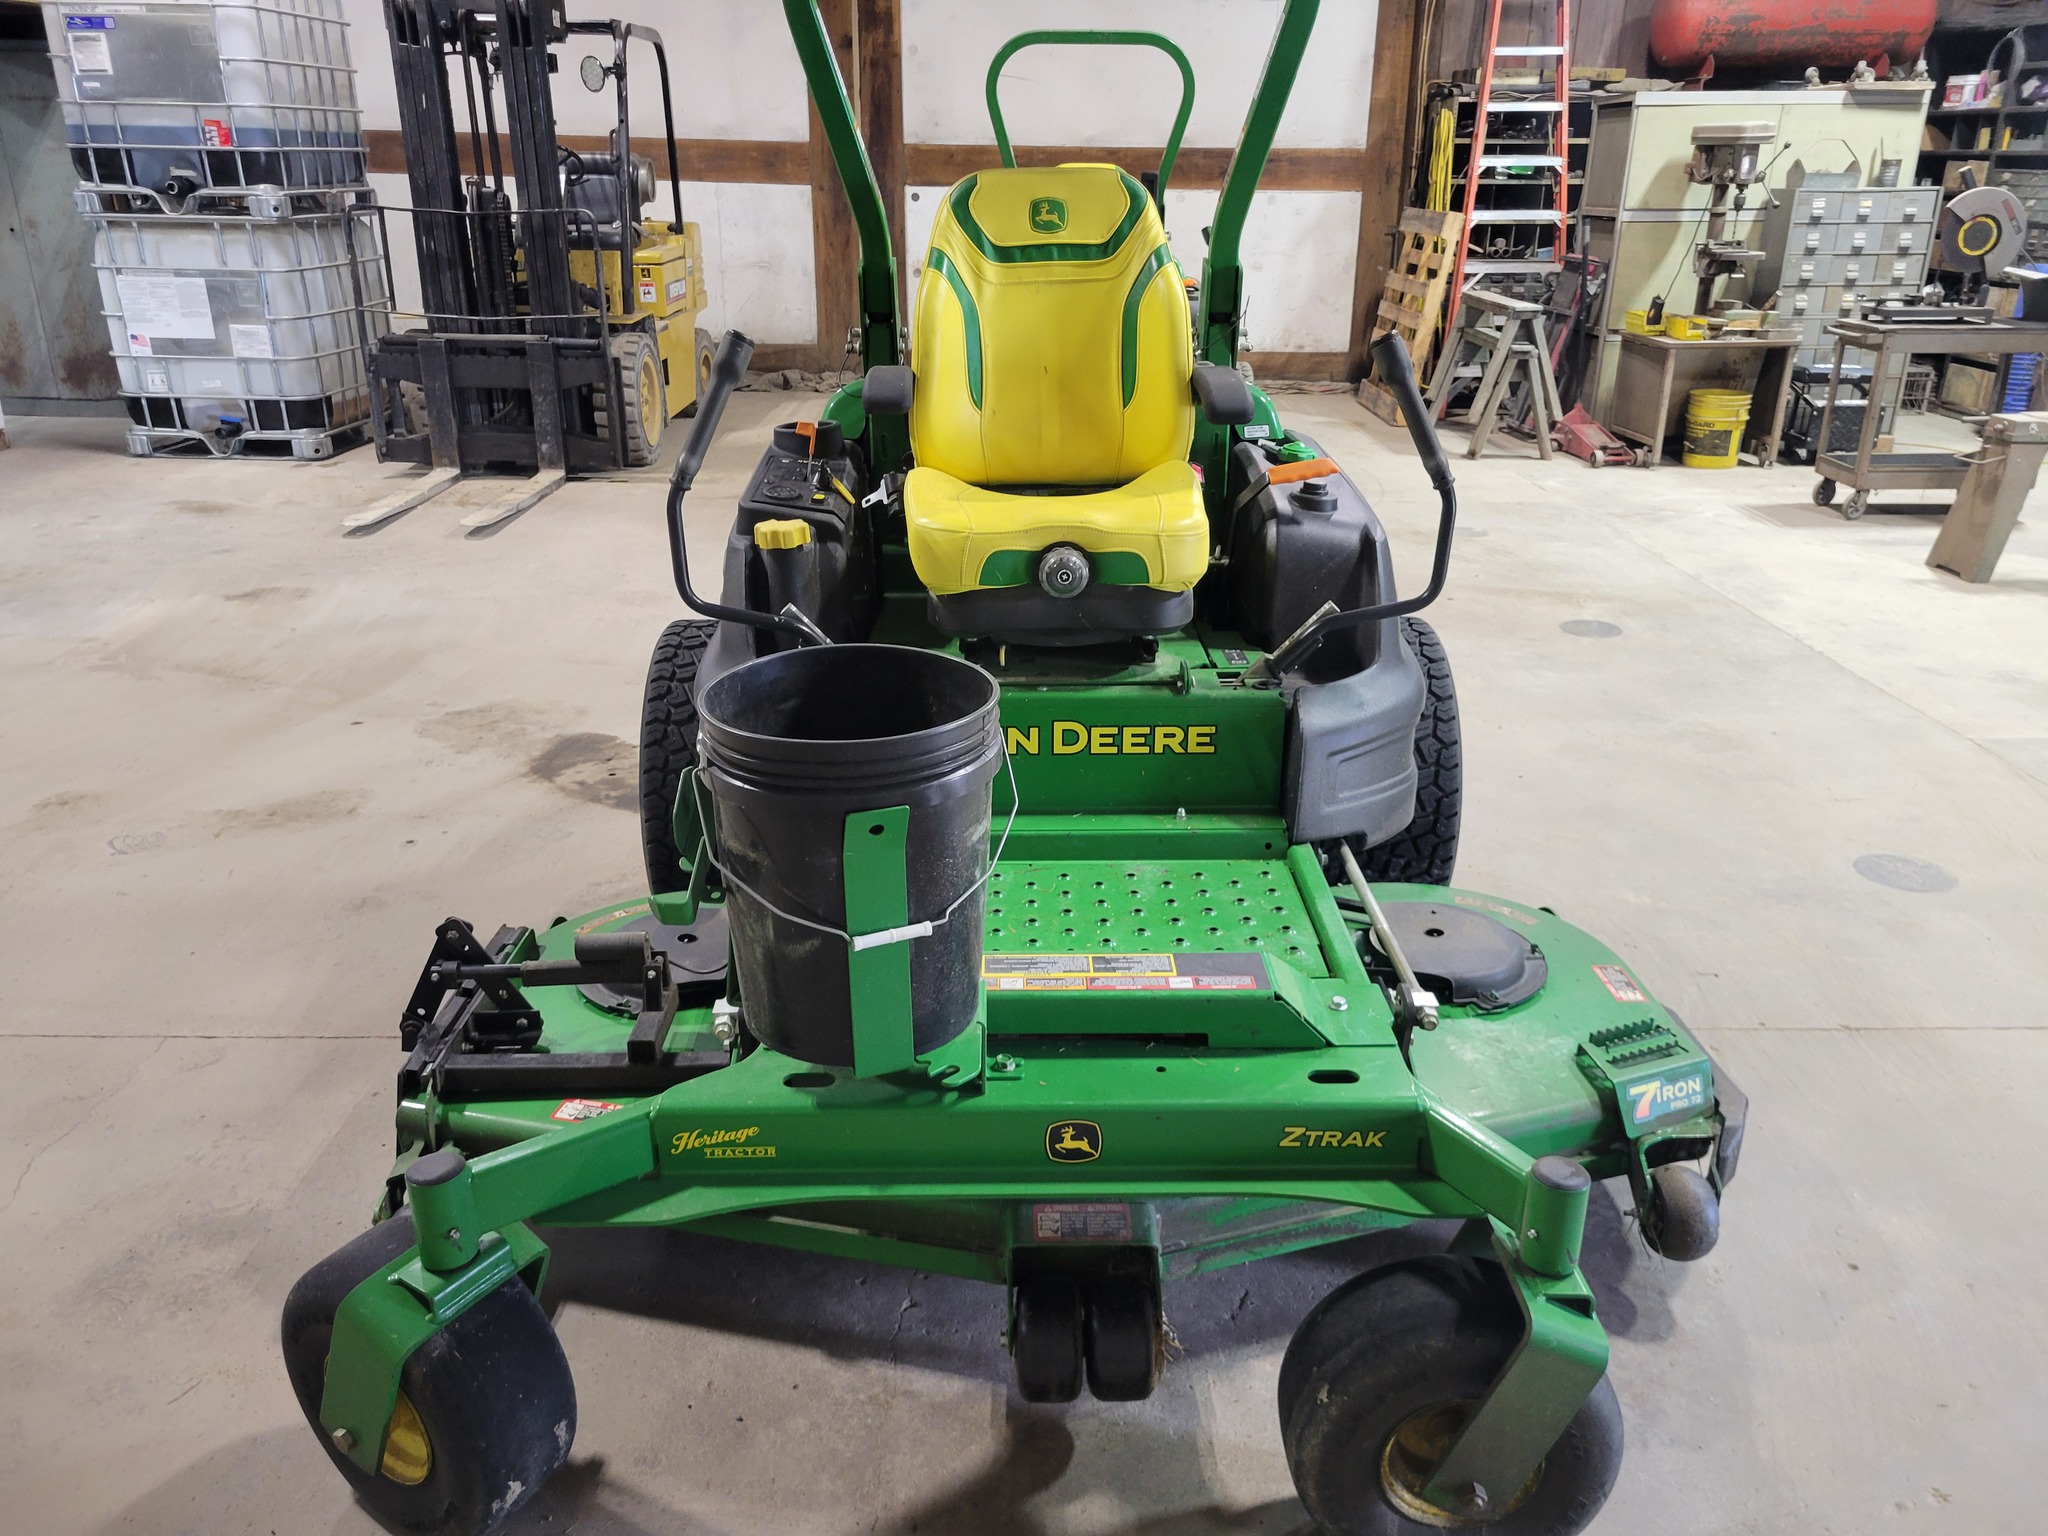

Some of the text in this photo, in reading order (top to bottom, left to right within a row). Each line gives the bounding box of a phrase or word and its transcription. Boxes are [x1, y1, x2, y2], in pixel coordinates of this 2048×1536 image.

[1052, 720, 1217, 755] DEERE
[671, 1126, 760, 1154] Heritage
[1278, 1126, 1388, 1147] ZTRAK
[704, 1147, 777, 1158] TRACTOR
